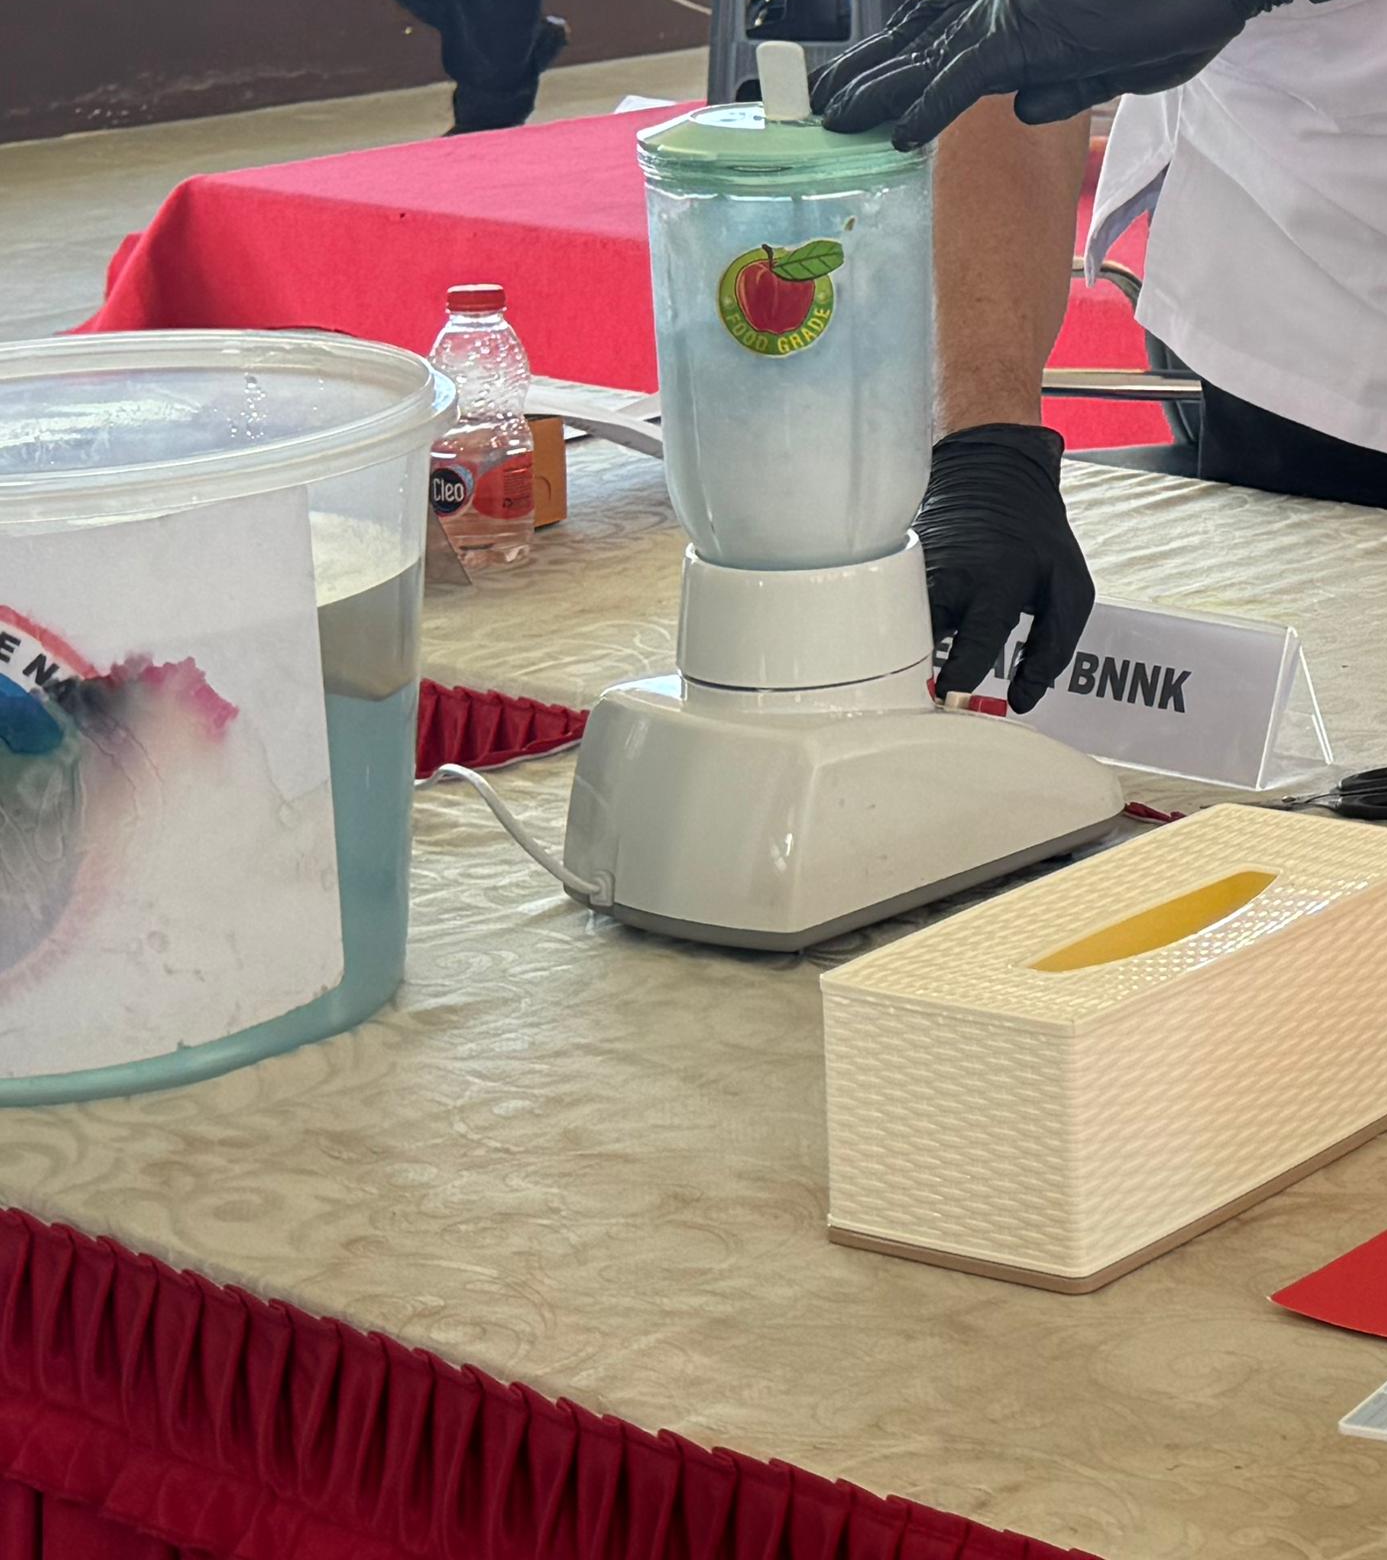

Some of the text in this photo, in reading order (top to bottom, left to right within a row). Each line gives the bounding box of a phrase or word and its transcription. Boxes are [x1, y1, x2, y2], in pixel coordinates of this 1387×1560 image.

[726, 307, 832, 354] FOOD GRADE
[433, 477, 466, 502] Cleo
[1067, 651, 1192, 714] BNNK
